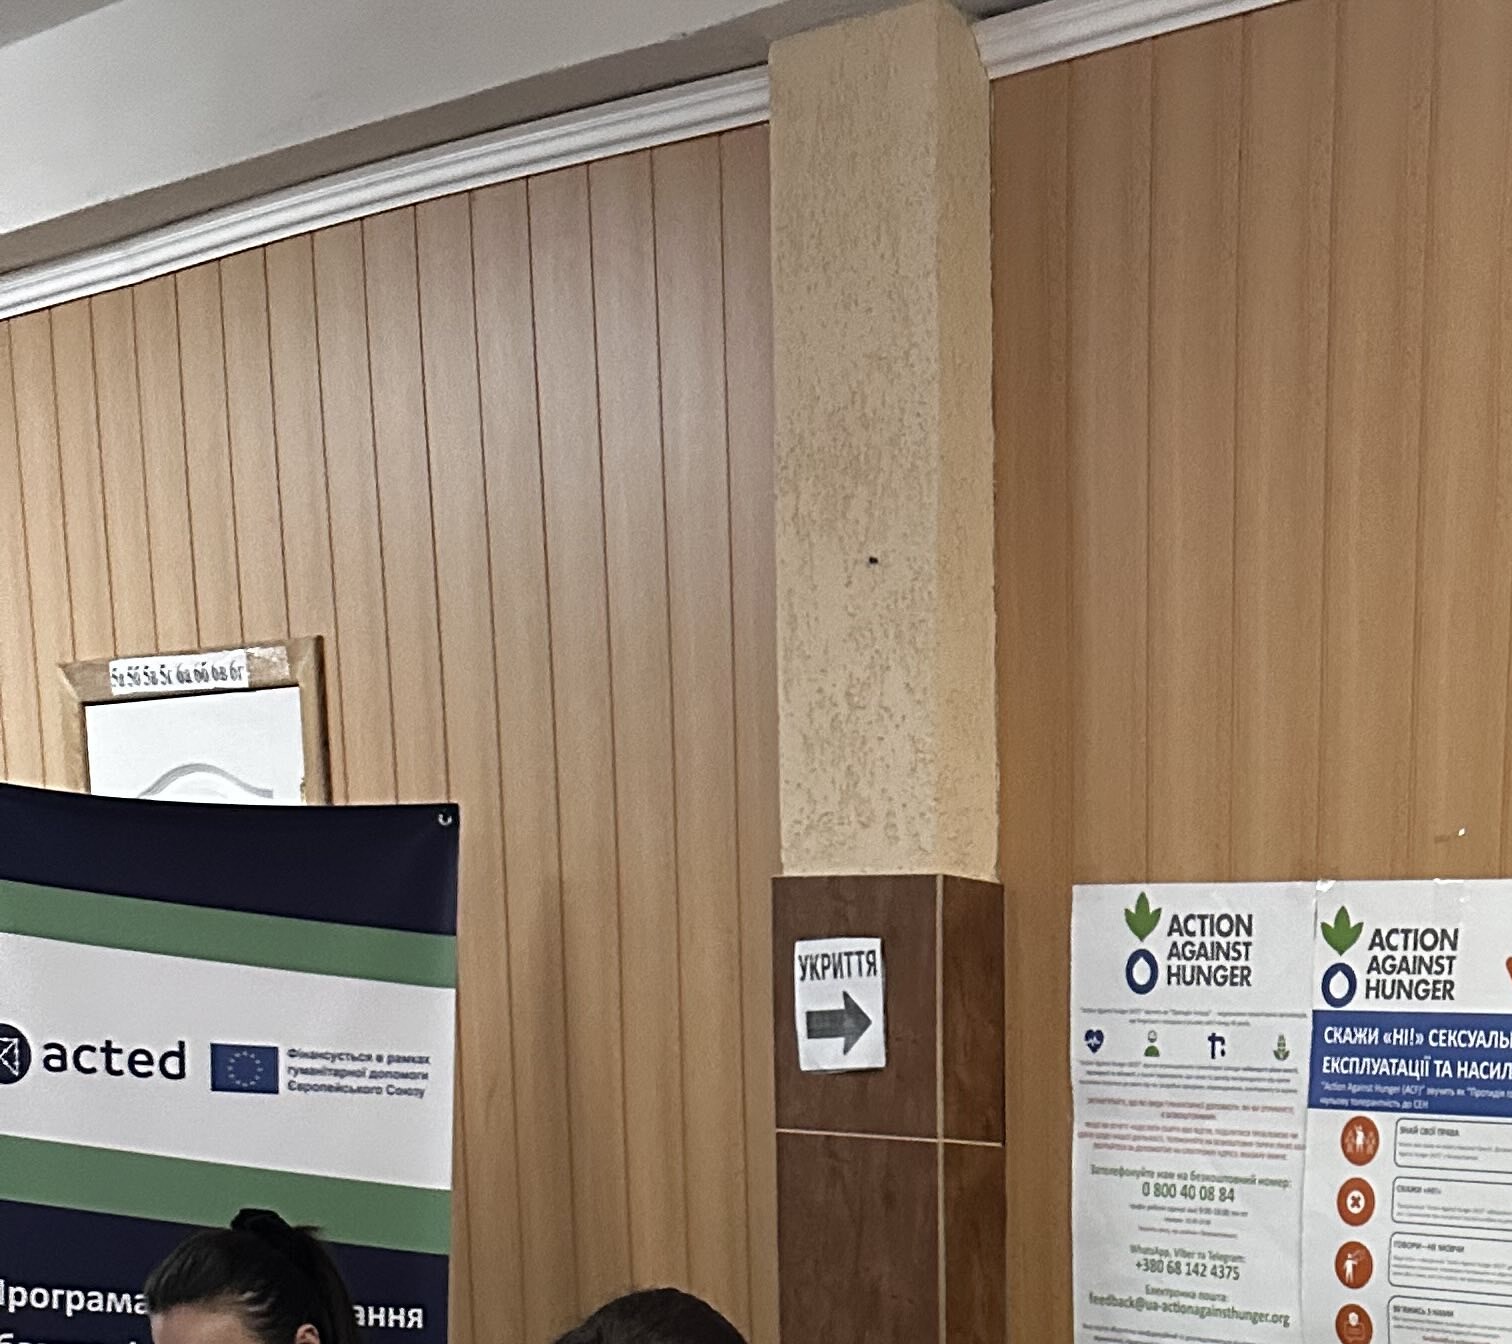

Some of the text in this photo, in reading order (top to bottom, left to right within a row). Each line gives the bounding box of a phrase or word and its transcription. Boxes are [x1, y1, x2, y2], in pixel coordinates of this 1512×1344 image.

[1167, 913, 1253, 937] ACTION
[1167, 941, 1252, 961] AGAINST
[1368, 928, 1459, 951] ACTION
[798, 949, 878, 981] УКРИТТЯ
[1166, 964, 1252, 987] HUNGER
[1366, 955, 1456, 976] AGAINST
[1365, 979, 1455, 1000] HUNGER
[1324, 1026, 1378, 1045] СКАЖИ
[1383, 1027, 1424, 1046] «НІ!»
[43, 1040, 186, 1081] acted
[1322, 1055, 1431, 1081] ЕКСПЛУАТАЦІЇ
[1434, 1060, 1451, 1078] ТА
[1142, 1182, 1235, 1203] 0 800 40 08 84
[1136, 1258, 1240, 1281] +380 68 142 4375
